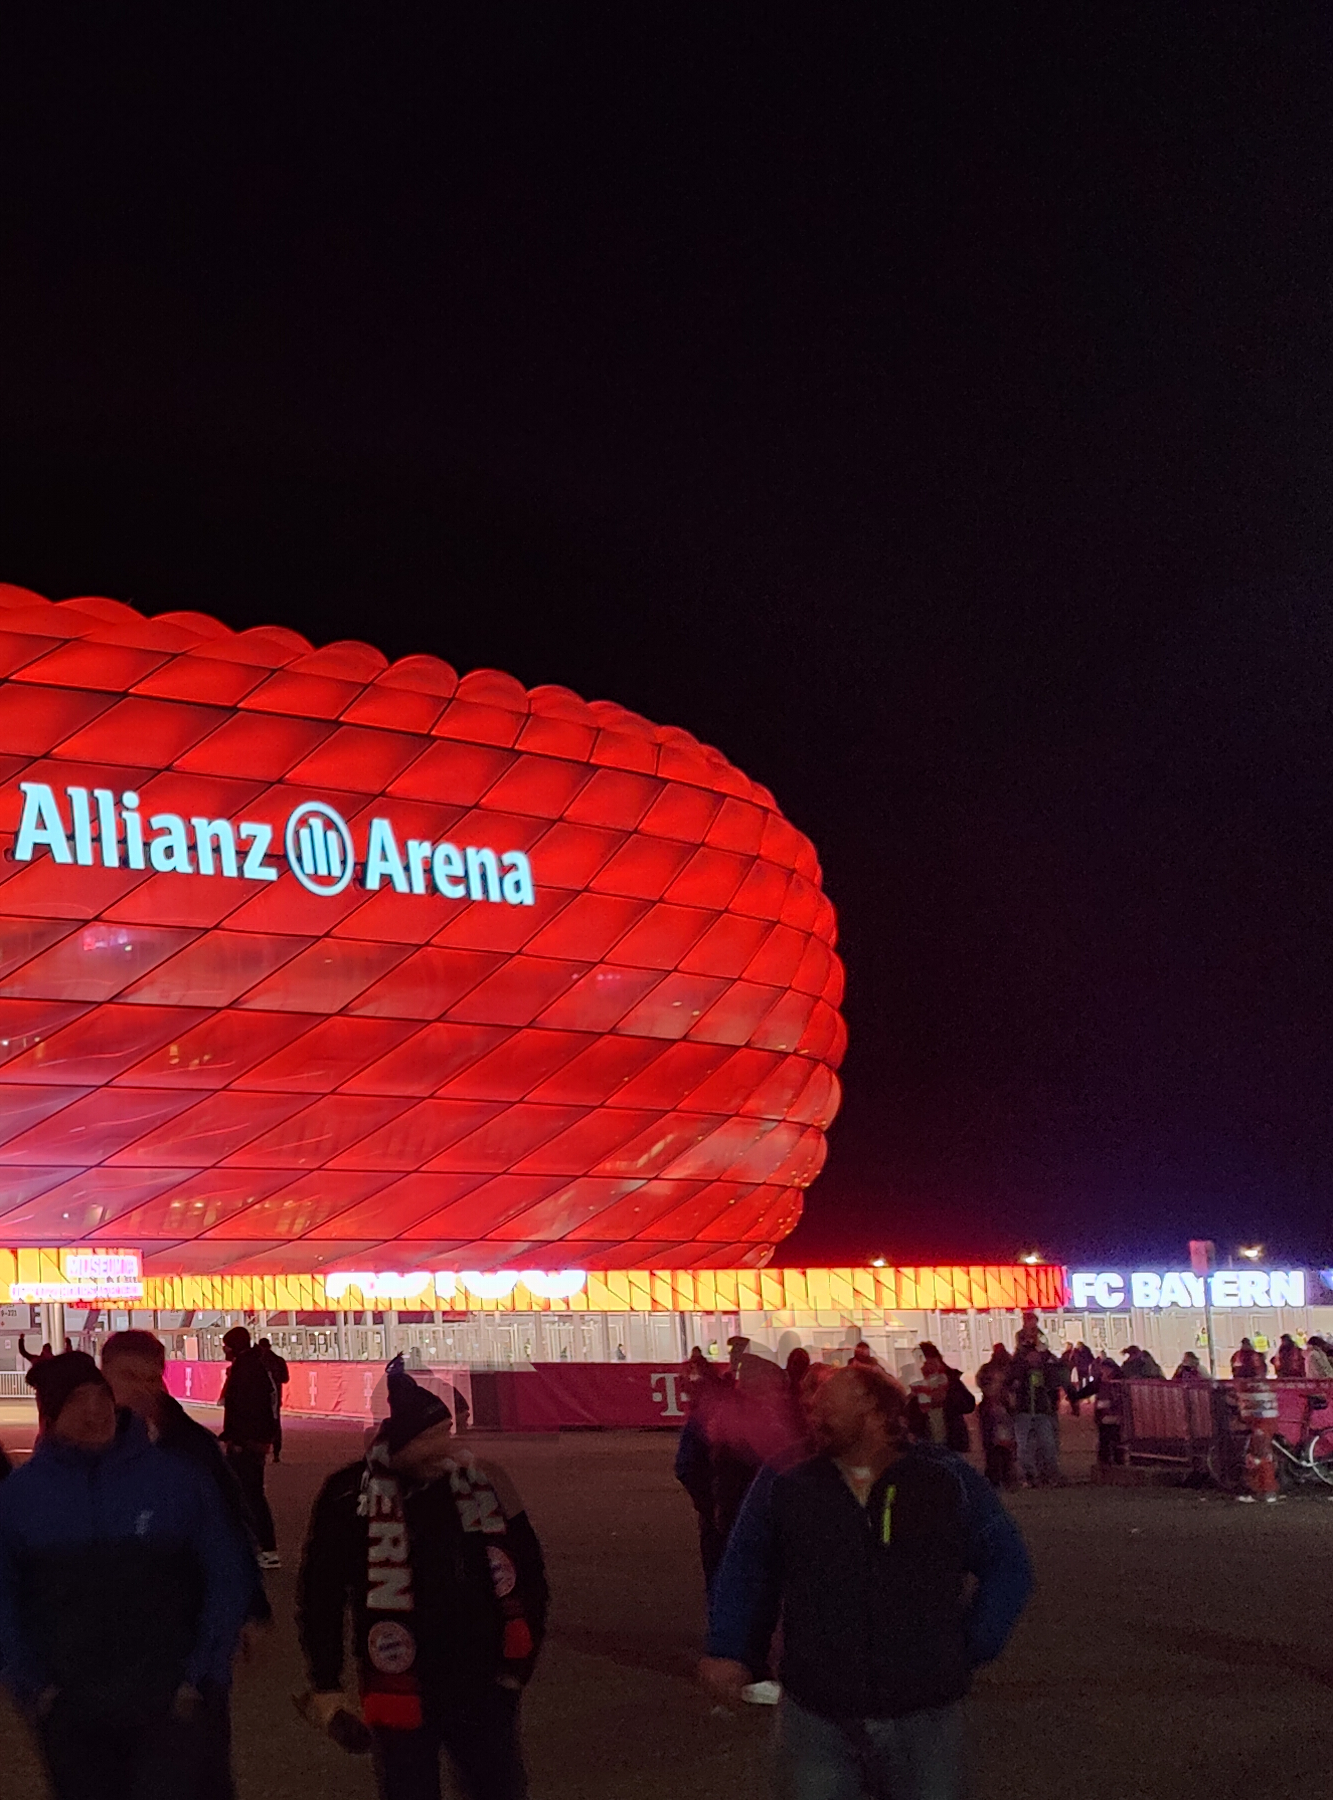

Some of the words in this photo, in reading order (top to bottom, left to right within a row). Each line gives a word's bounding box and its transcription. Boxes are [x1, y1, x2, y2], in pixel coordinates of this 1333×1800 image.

[14, 782, 278, 881] Allianz
[366, 818, 535, 906] Arena
[1071, 1272, 1125, 1308] FC
[1131, 1270, 1305, 1308] BAYERN
[651, 1373, 689, 1416] T
